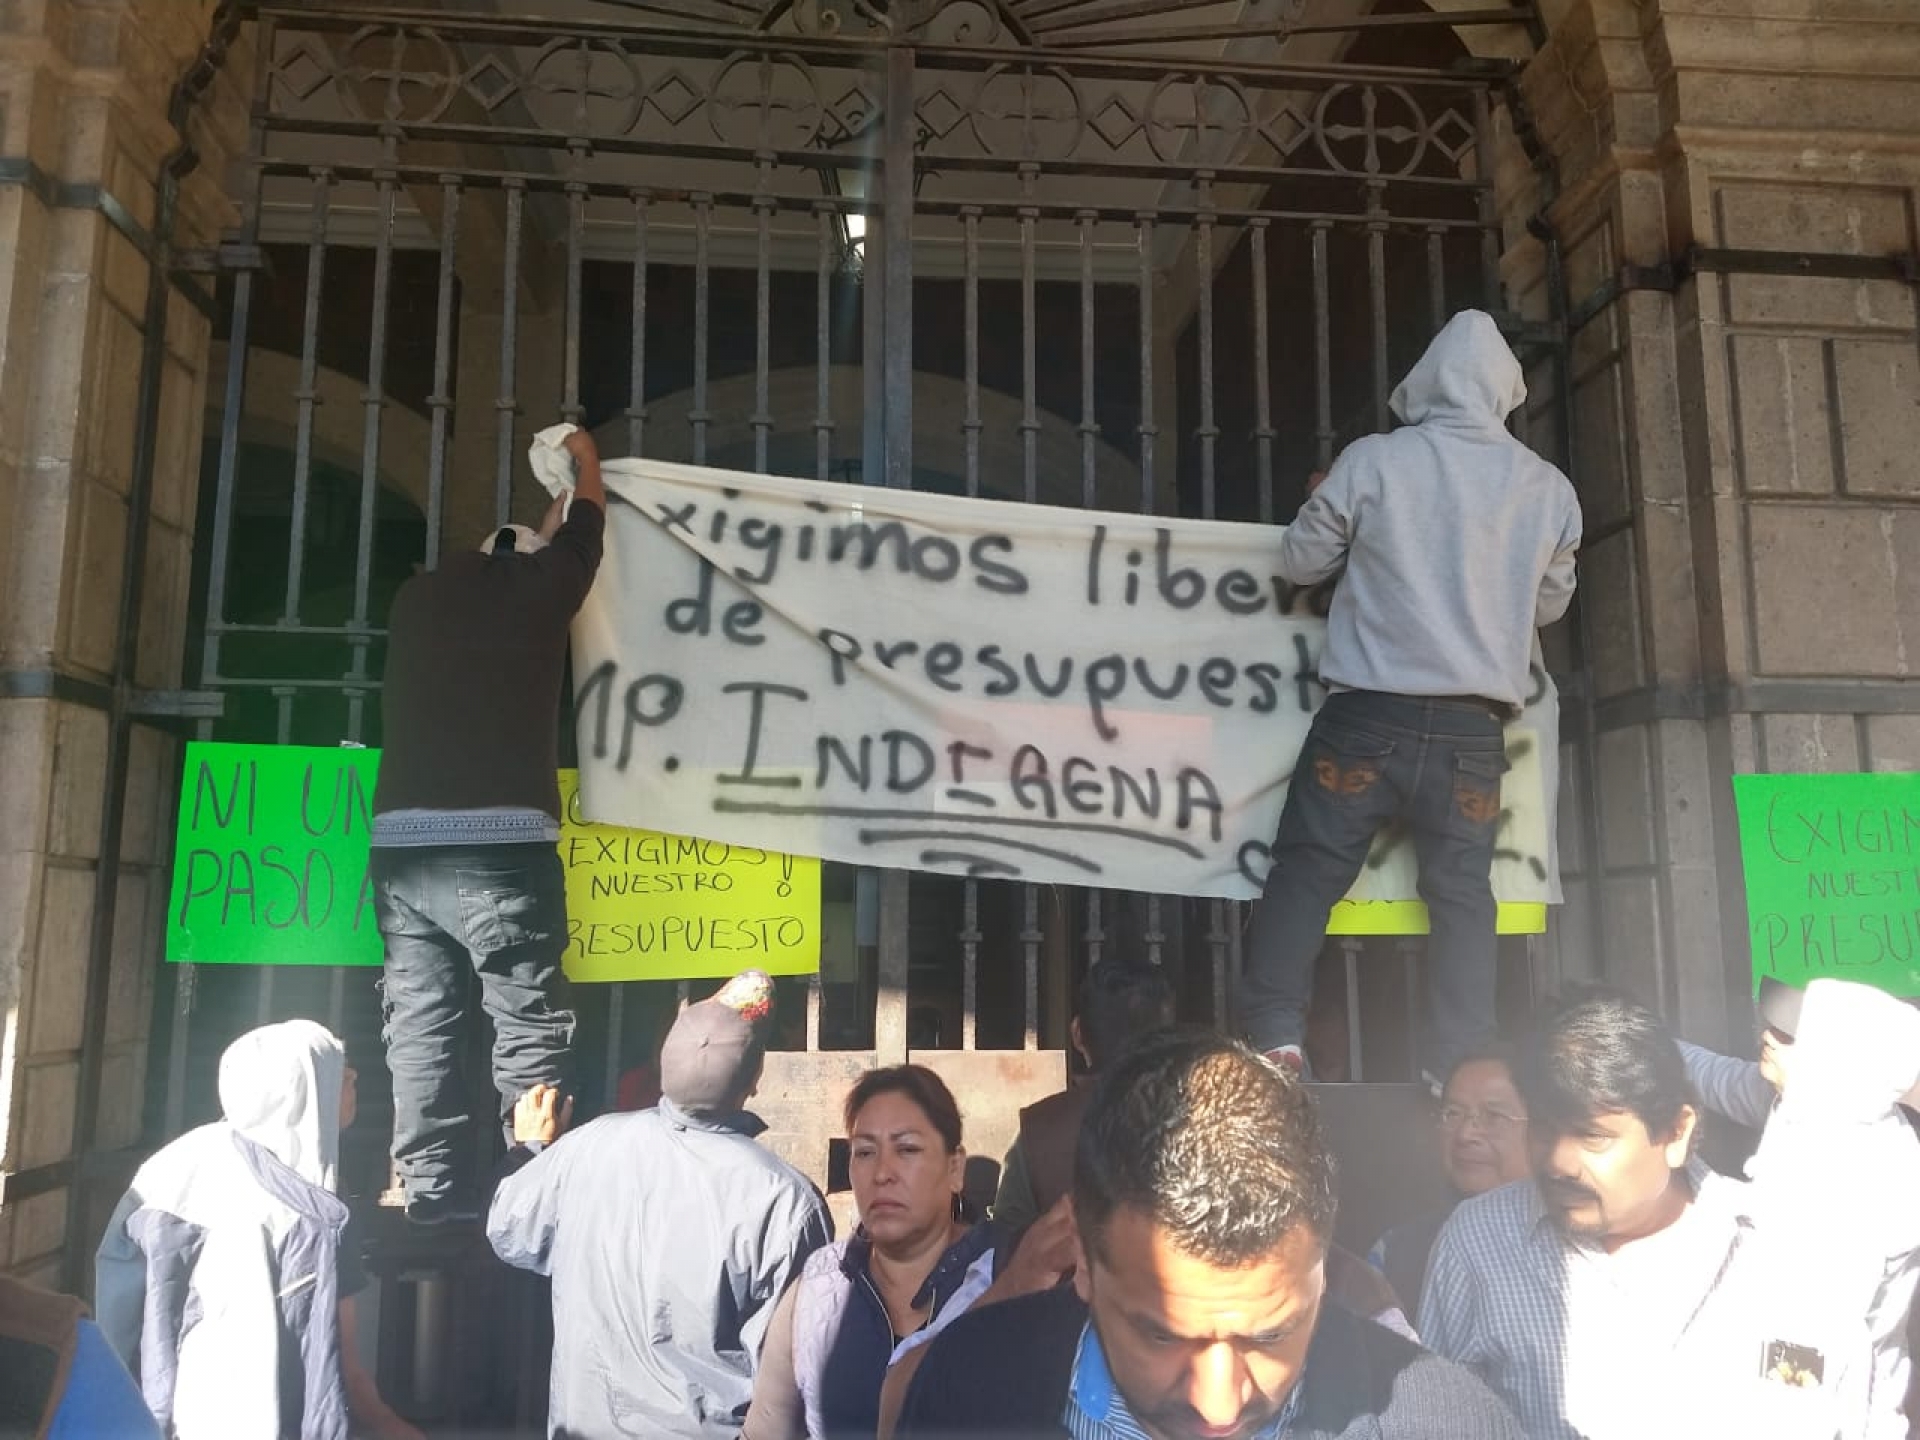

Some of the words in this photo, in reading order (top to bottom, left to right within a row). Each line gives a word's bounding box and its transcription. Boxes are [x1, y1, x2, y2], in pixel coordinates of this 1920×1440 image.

[606, 487, 1029, 595] xigimos
[664, 560, 767, 647] de
[817, 626, 1322, 741] presupuest
[191, 759, 257, 836] NI
[568, 835, 767, 868] EXIGIMOS
[1806, 866, 1920, 900] NUEST
[179, 845, 335, 930] PASO
[591, 871, 733, 900] NUESTRO
[567, 915, 805, 960] RESUPUESTO
[1754, 910, 1920, 973] PRESU
